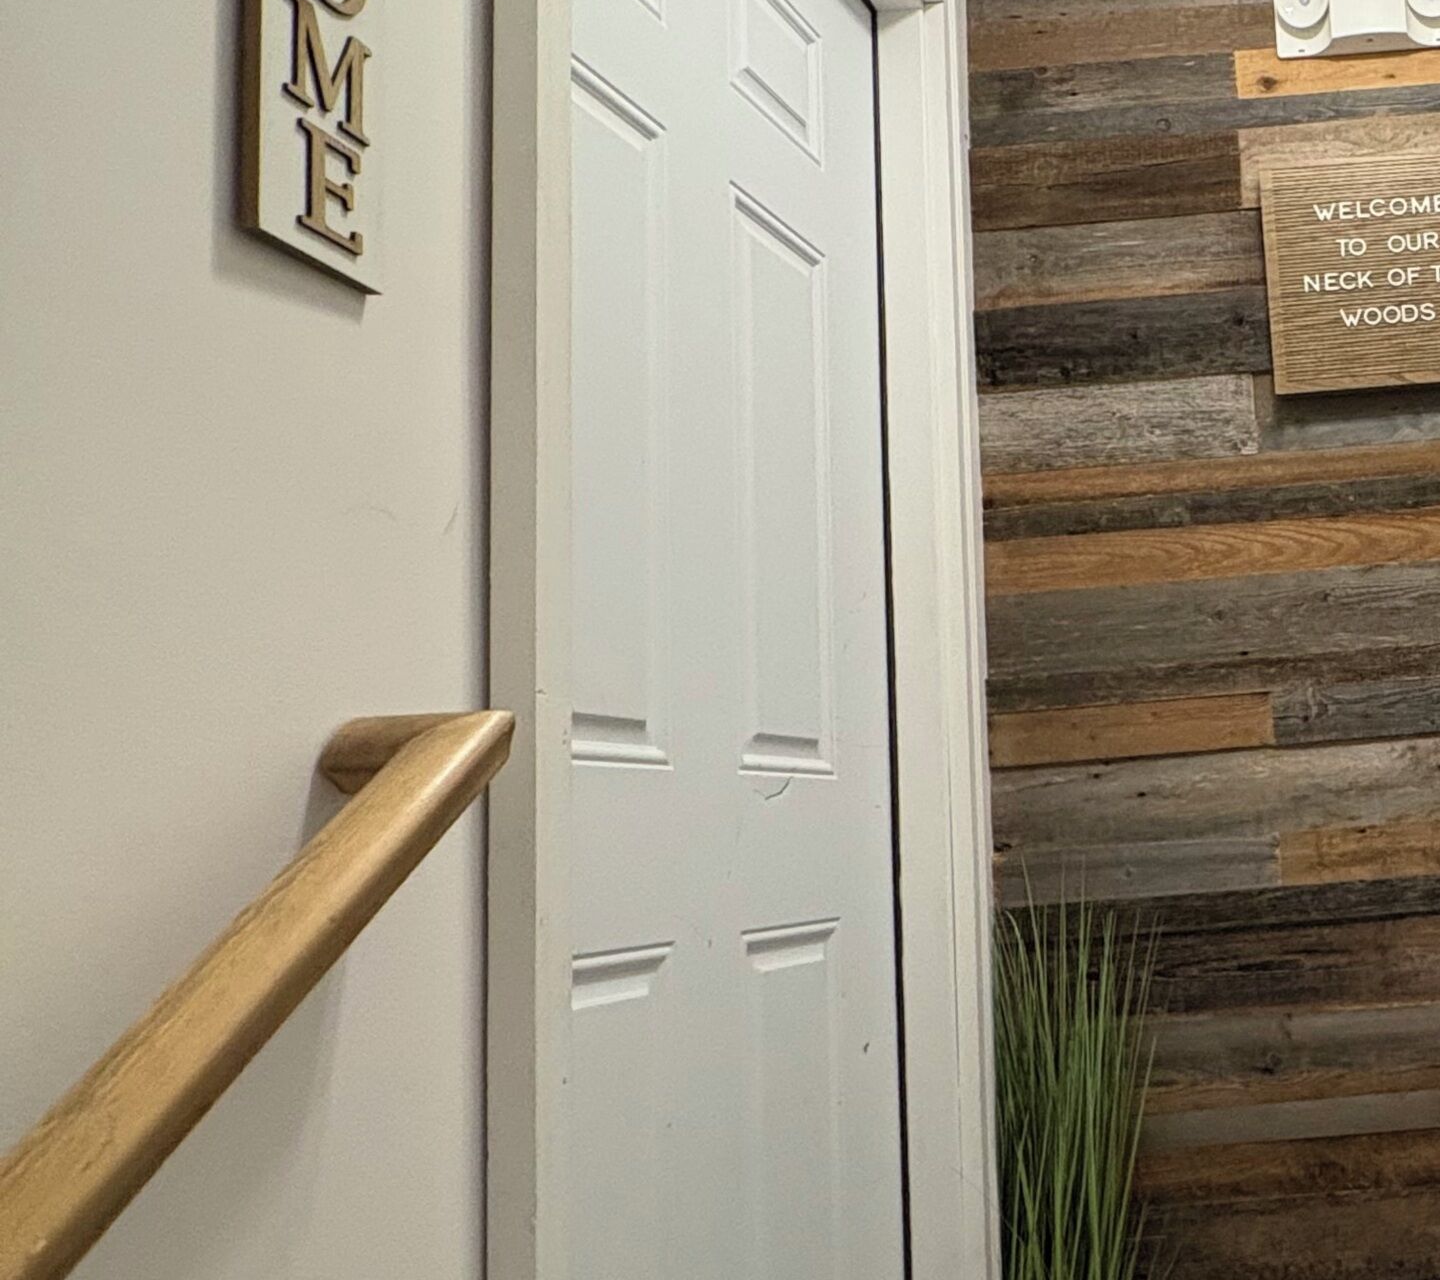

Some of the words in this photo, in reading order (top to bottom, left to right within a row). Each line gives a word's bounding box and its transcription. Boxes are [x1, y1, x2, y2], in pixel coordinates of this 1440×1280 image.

[1336, 237, 1367, 257] TO
[1387, 231, 1440, 252] OUR
[1303, 270, 1374, 293] NECK
[1387, 266, 1421, 287] OF
[1339, 303, 1436, 327] WOODS
